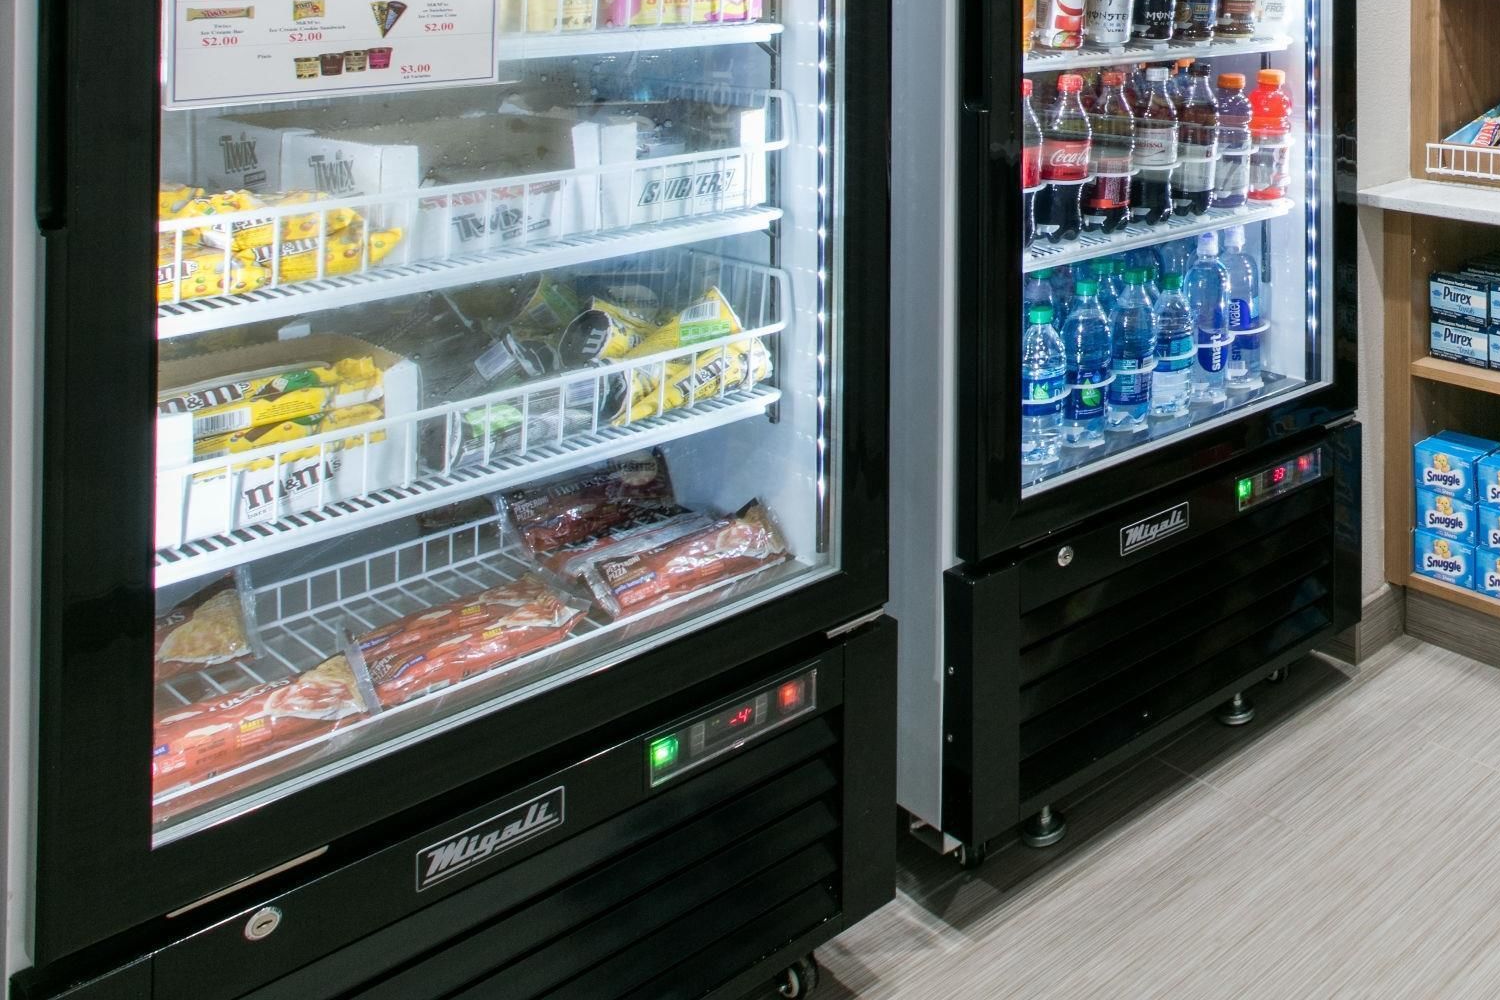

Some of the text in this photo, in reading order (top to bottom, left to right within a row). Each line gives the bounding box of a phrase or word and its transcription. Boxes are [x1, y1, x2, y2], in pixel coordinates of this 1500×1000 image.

[424, 23, 454, 32] $2.00
[202, 37, 238, 47] $2.00
[289, 32, 322, 42] $2.00
[400, 64, 430, 74] $3.00
[1443, 287, 1471, 305] Purex
[1444, 328, 1472, 347] Purex
[1427, 471, 1460, 486] Snuggle
[1126, 510, 1184, 546] Migali
[1429, 514, 1463, 529] Snuggle
[1427, 557, 1461, 573] Snuggle
[427, 801, 560, 875] Migali
